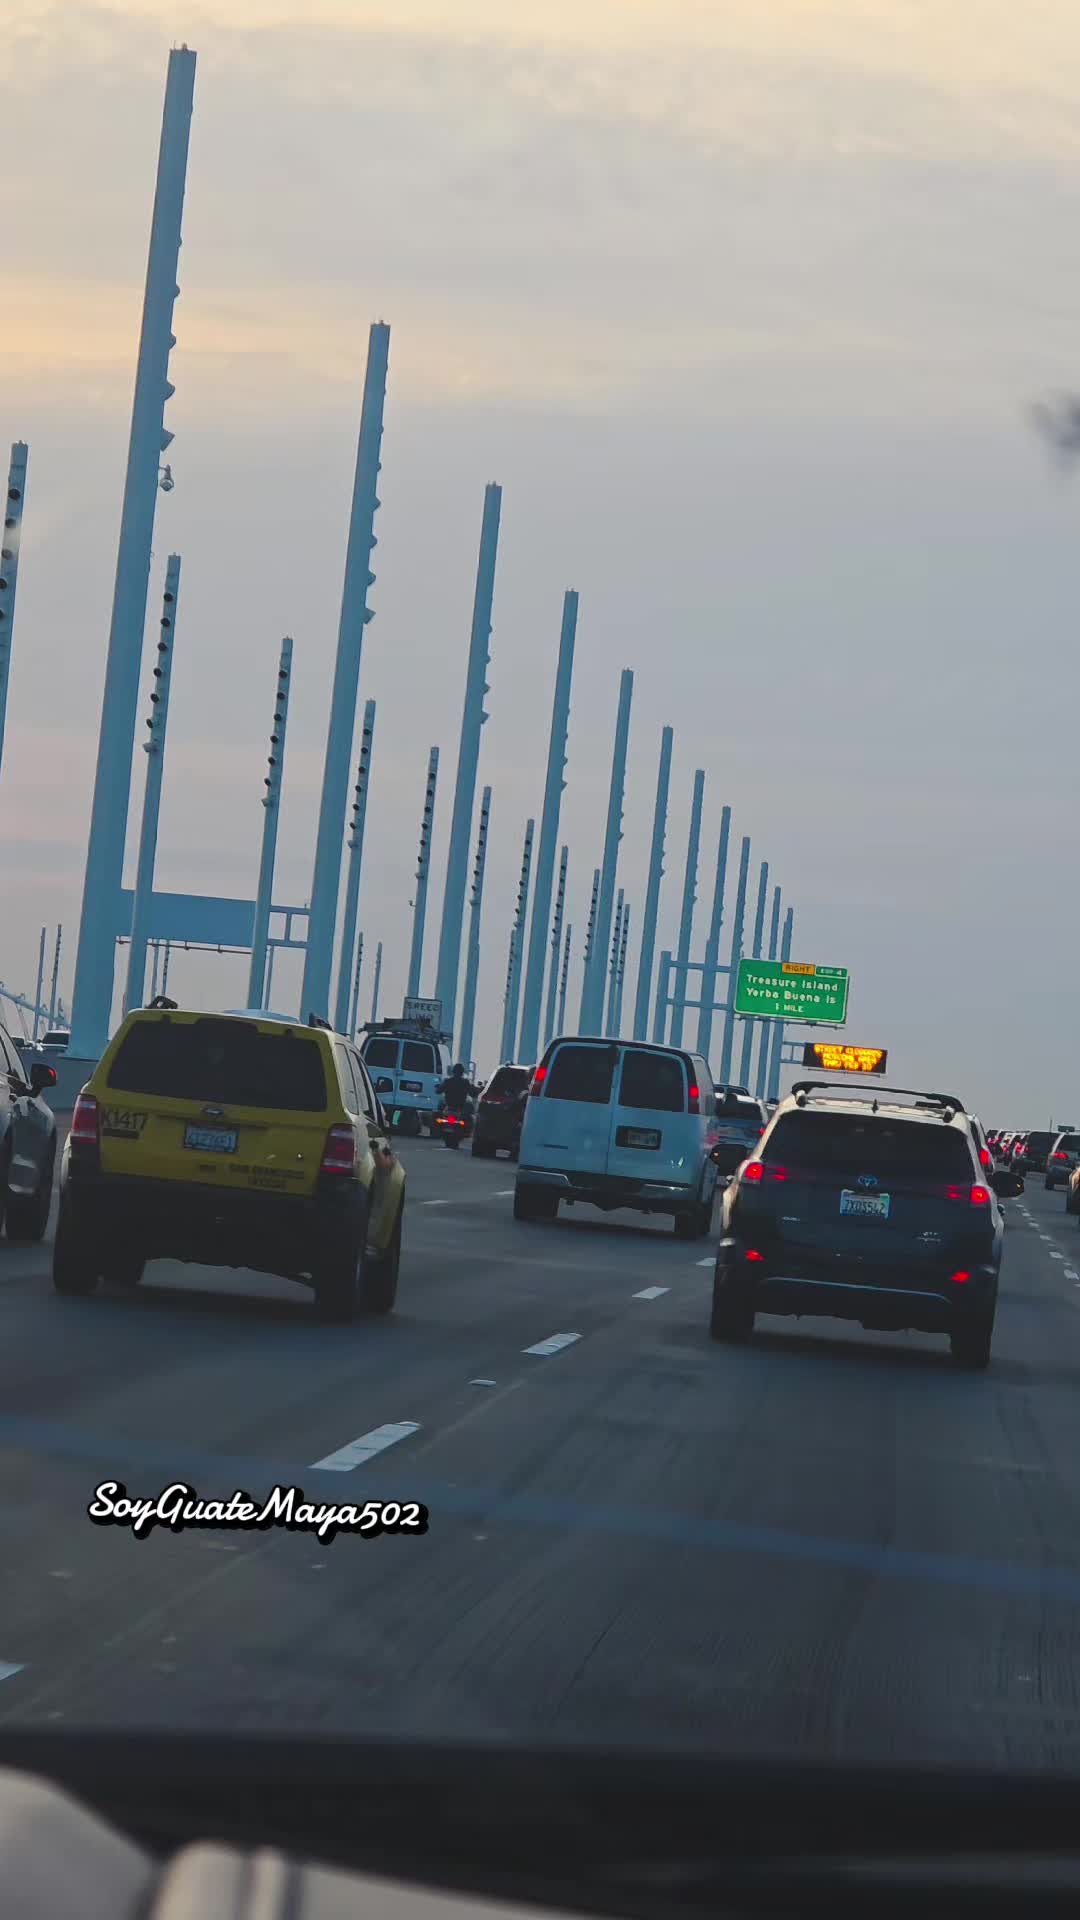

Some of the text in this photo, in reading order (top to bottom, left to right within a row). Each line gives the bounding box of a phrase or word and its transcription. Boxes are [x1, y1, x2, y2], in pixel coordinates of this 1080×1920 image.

[785, 964, 811, 974] RIGHT
[746, 974, 839, 992] Treasure Island
[746, 987, 779, 999] Yerba
[784, 990, 820, 1003] Buena
[784, 1004, 804, 1013] MILE
